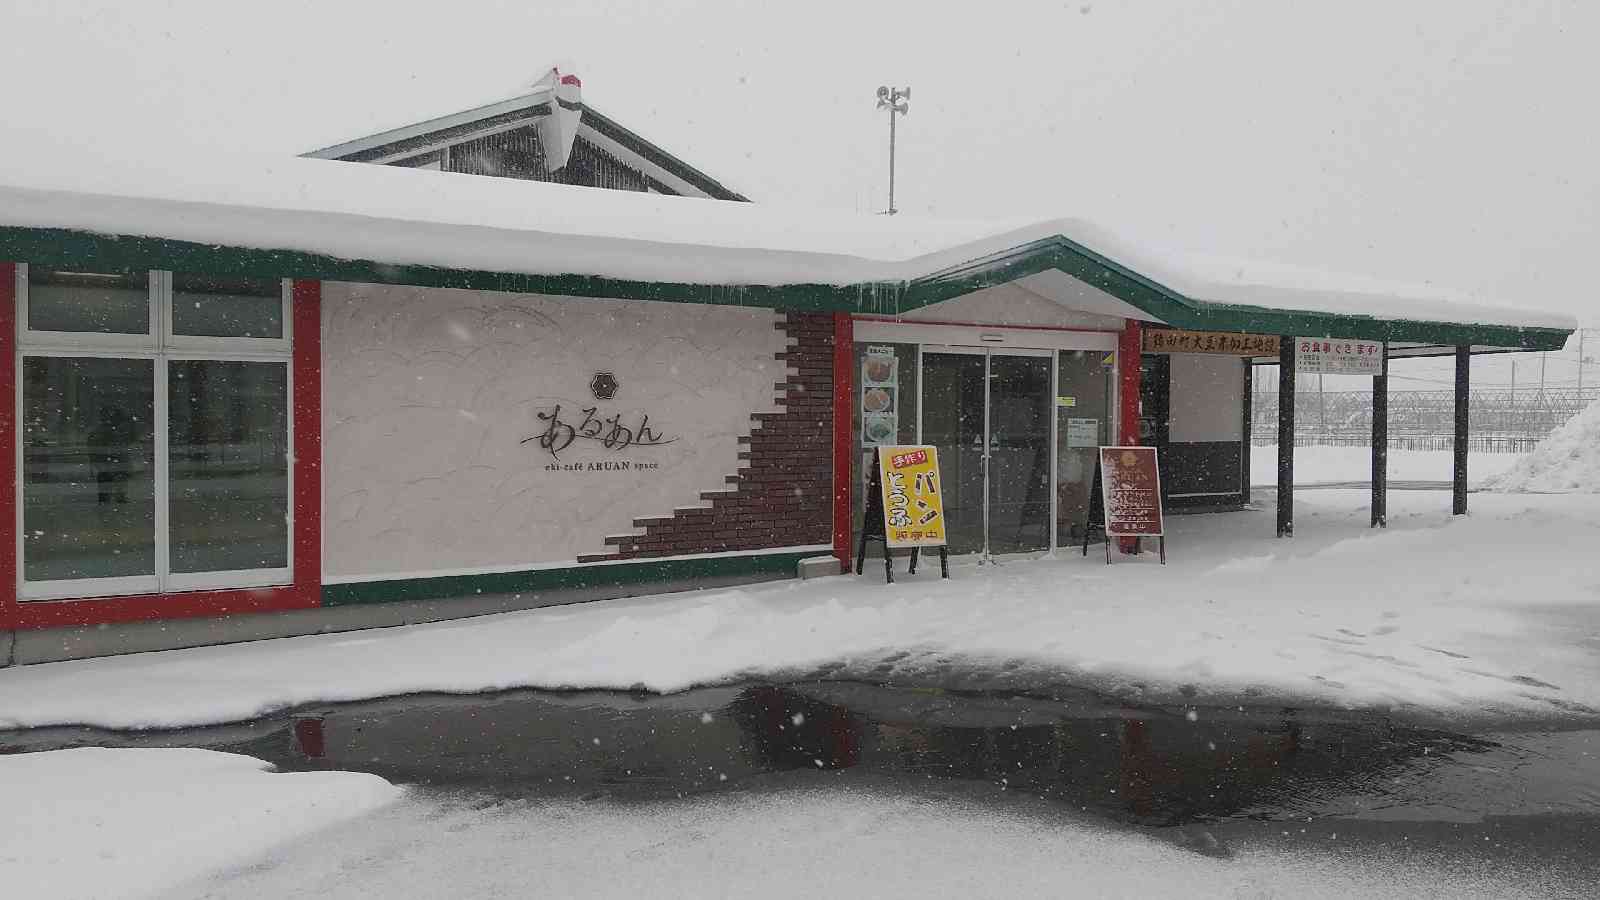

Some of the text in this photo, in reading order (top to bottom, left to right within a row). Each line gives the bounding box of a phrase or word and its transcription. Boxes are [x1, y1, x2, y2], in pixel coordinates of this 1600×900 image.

[528, 404, 669, 461] あるあん
[894, 451, 926, 468] 手作り
[587, 462, 630, 471] ARUAN
[634, 463, 659, 472] space
[887, 471, 913, 528] とうふ
[915, 471, 938, 525] パン
